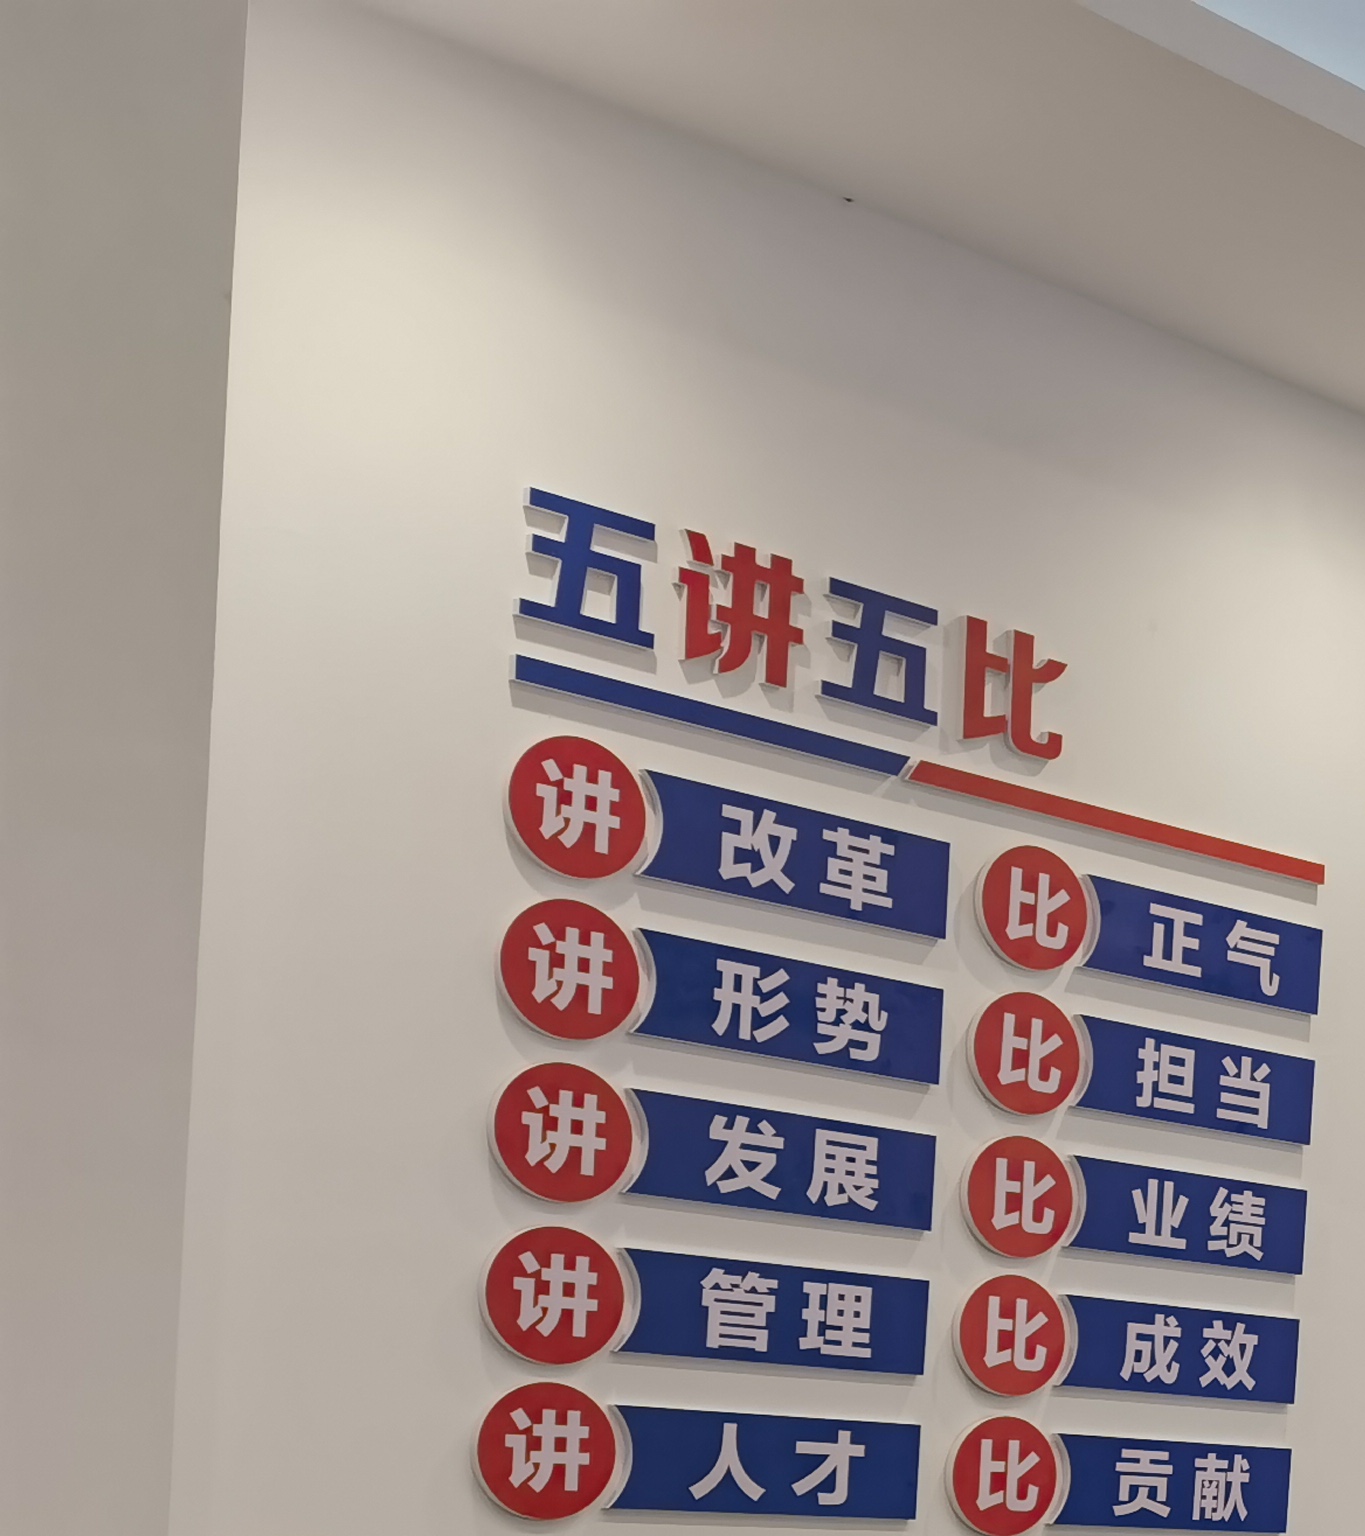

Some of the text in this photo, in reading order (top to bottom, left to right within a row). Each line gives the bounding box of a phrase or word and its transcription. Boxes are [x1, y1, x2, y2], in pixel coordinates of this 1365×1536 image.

[514, 486, 1068, 761] 五讲五比
[536, 759, 895, 911] 讲 改革
[1006, 867, 1280, 996] 比 正气
[529, 923, 888, 1061] 讲 形势
[998, 1013, 1271, 1129] 比 担当
[522, 1087, 879, 1211] 讲 发展
[992, 1158, 1266, 1261] 比 业绩
[514, 1252, 872, 1358] 讲 管理
[984, 1296, 1258, 1390] 比 成效
[506, 1409, 865, 1505] 讲 人才
[977, 1439, 1250, 1522] 比 贡献
